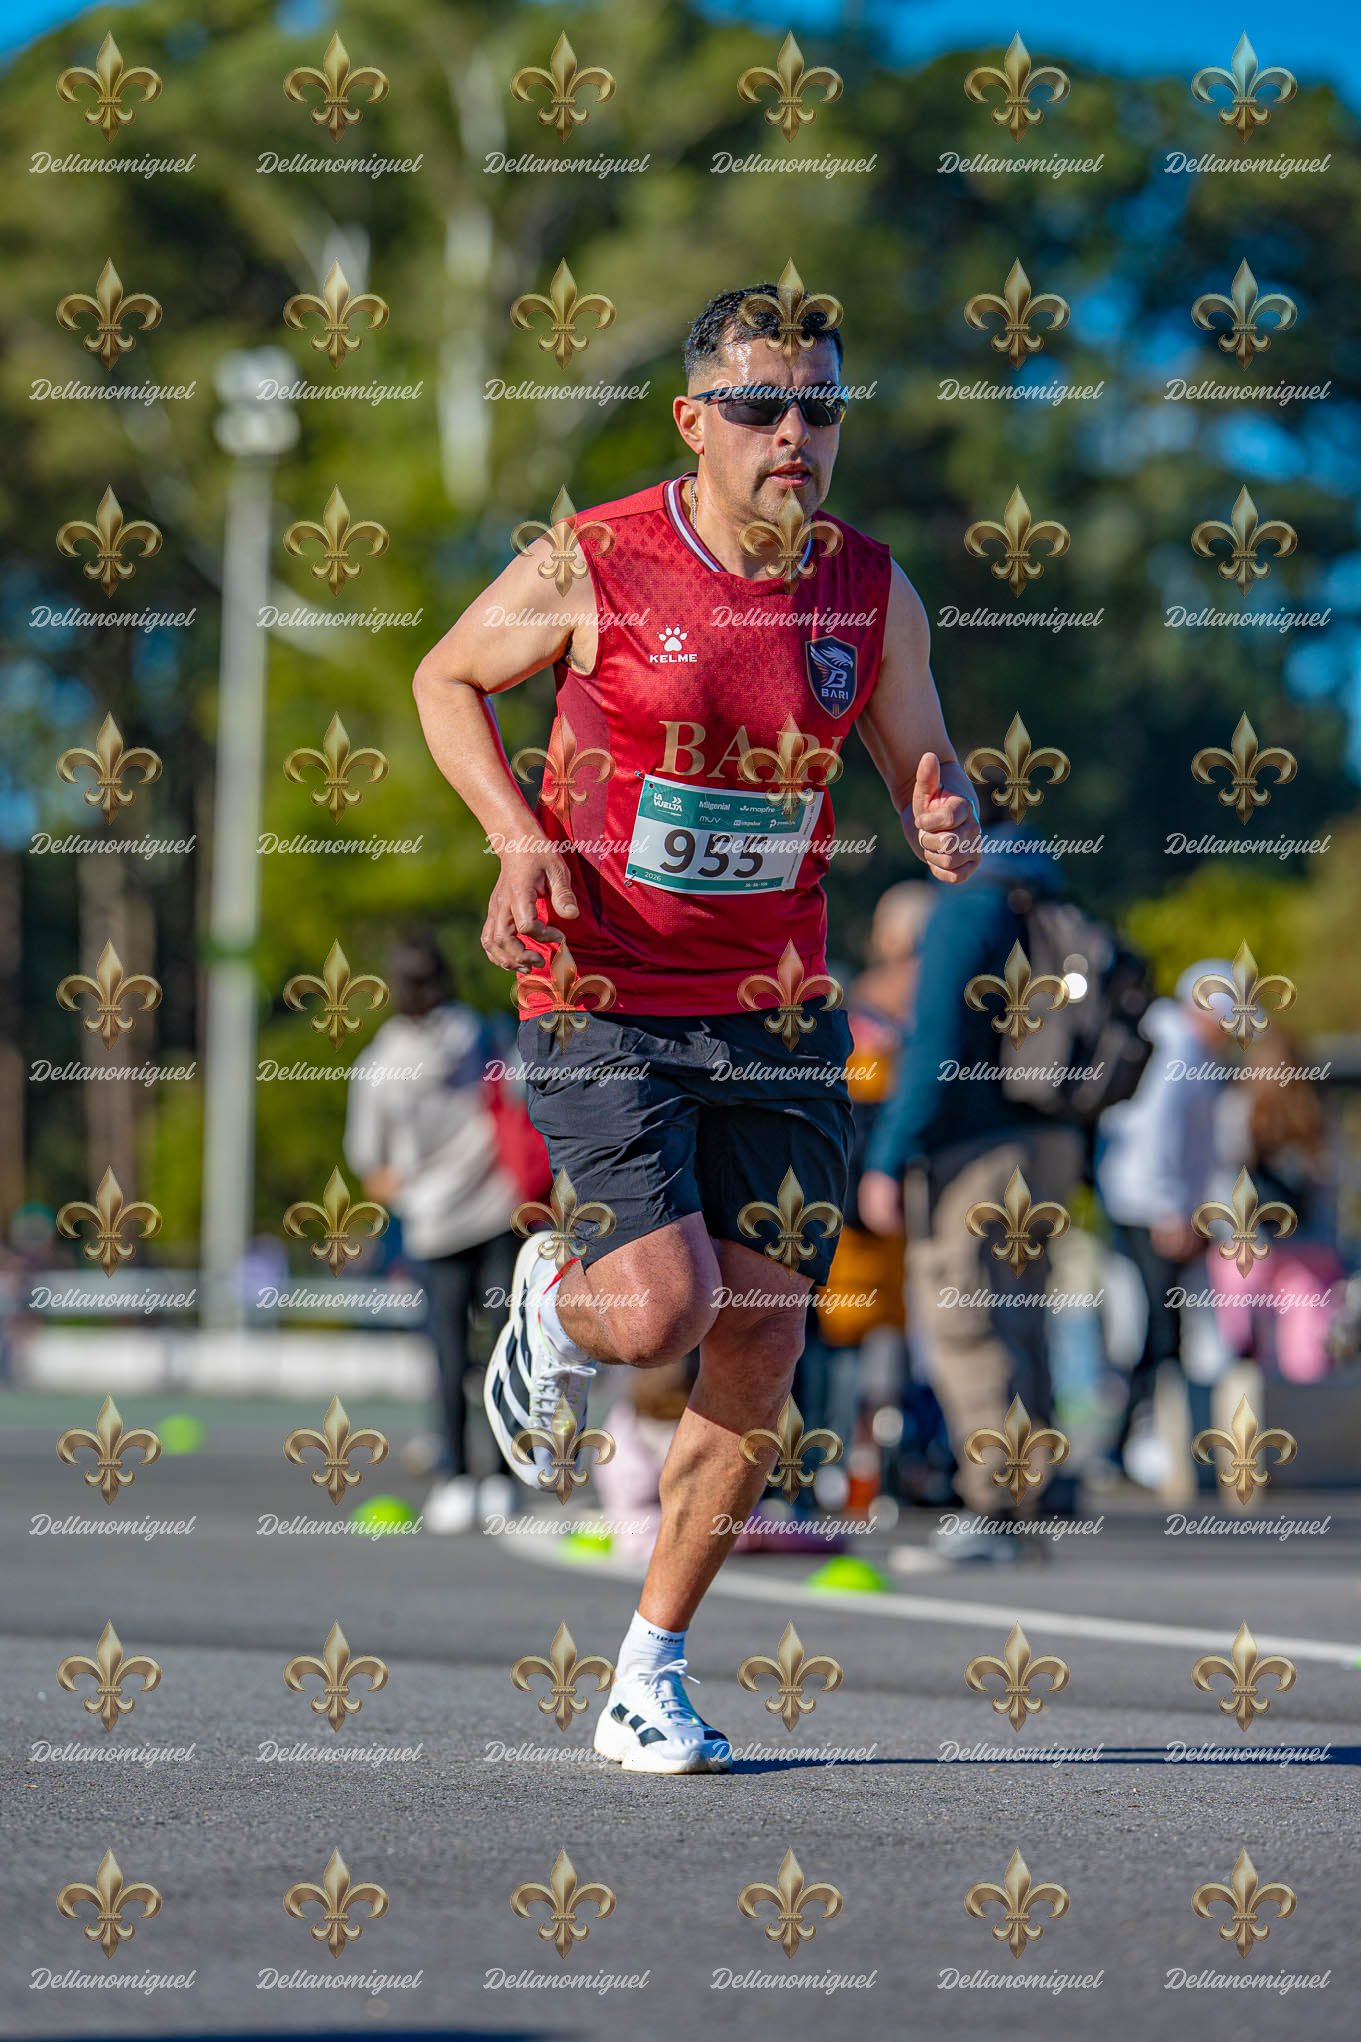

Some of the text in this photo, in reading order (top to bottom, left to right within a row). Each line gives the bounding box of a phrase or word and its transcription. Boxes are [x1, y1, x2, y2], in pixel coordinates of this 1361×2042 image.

[649, 653, 698, 663] KELME
[821, 687, 849, 700] BARI
[655, 720, 844, 786] BARI
[653, 799, 682, 811] VUELTA
[659, 828, 767, 879] 955
[644, 871, 663, 882] 2026
